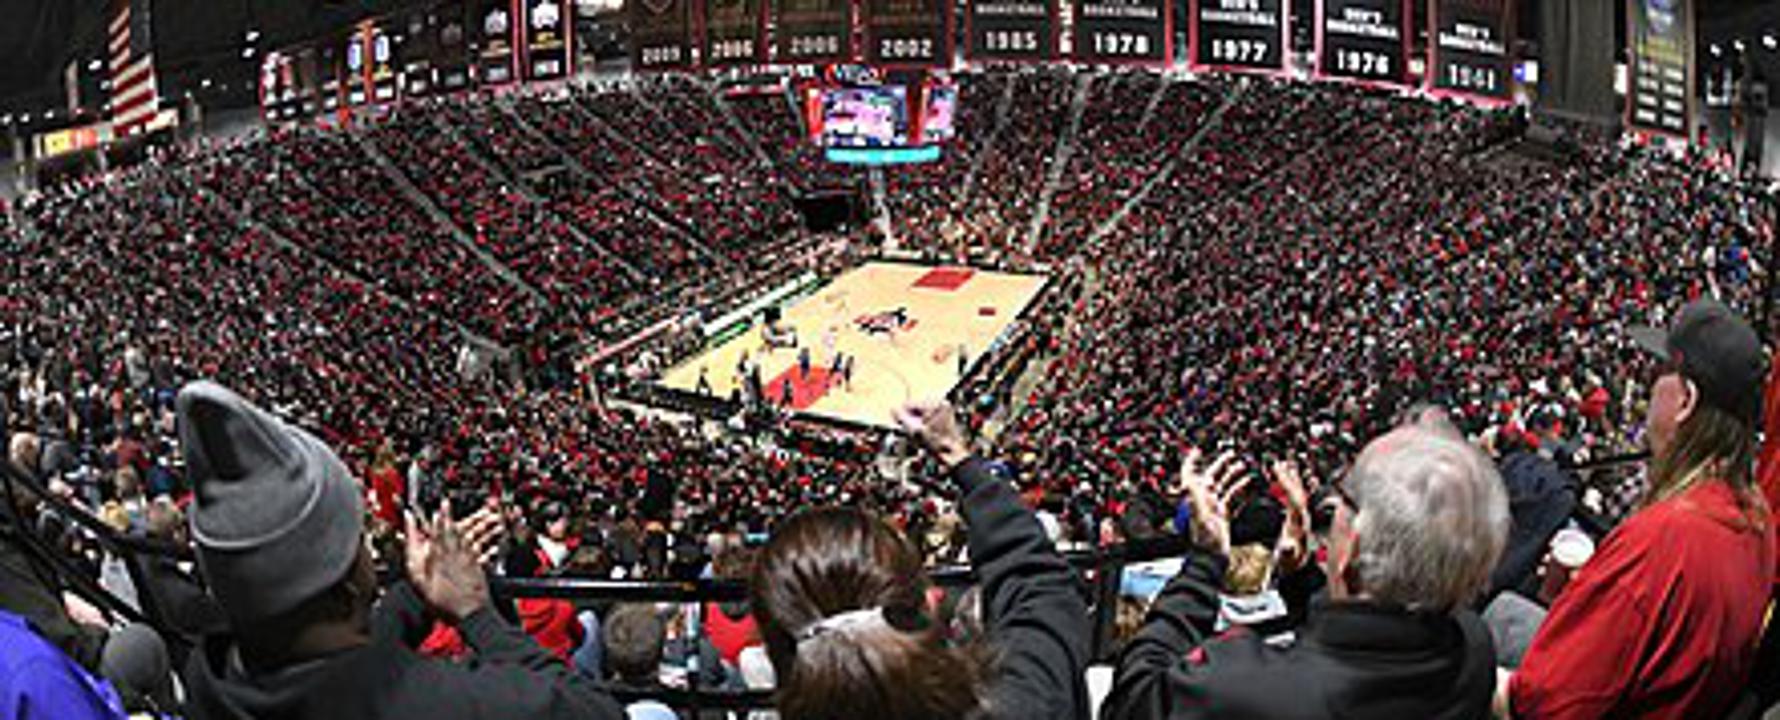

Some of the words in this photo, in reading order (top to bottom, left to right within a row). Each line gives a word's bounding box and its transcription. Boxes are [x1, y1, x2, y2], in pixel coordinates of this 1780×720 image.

[881, 38, 932, 57] 2002
[1094, 32, 1149, 54] 1978
[1212, 39, 1267, 61] 1977
[1337, 49, 1389, 74] 1976
